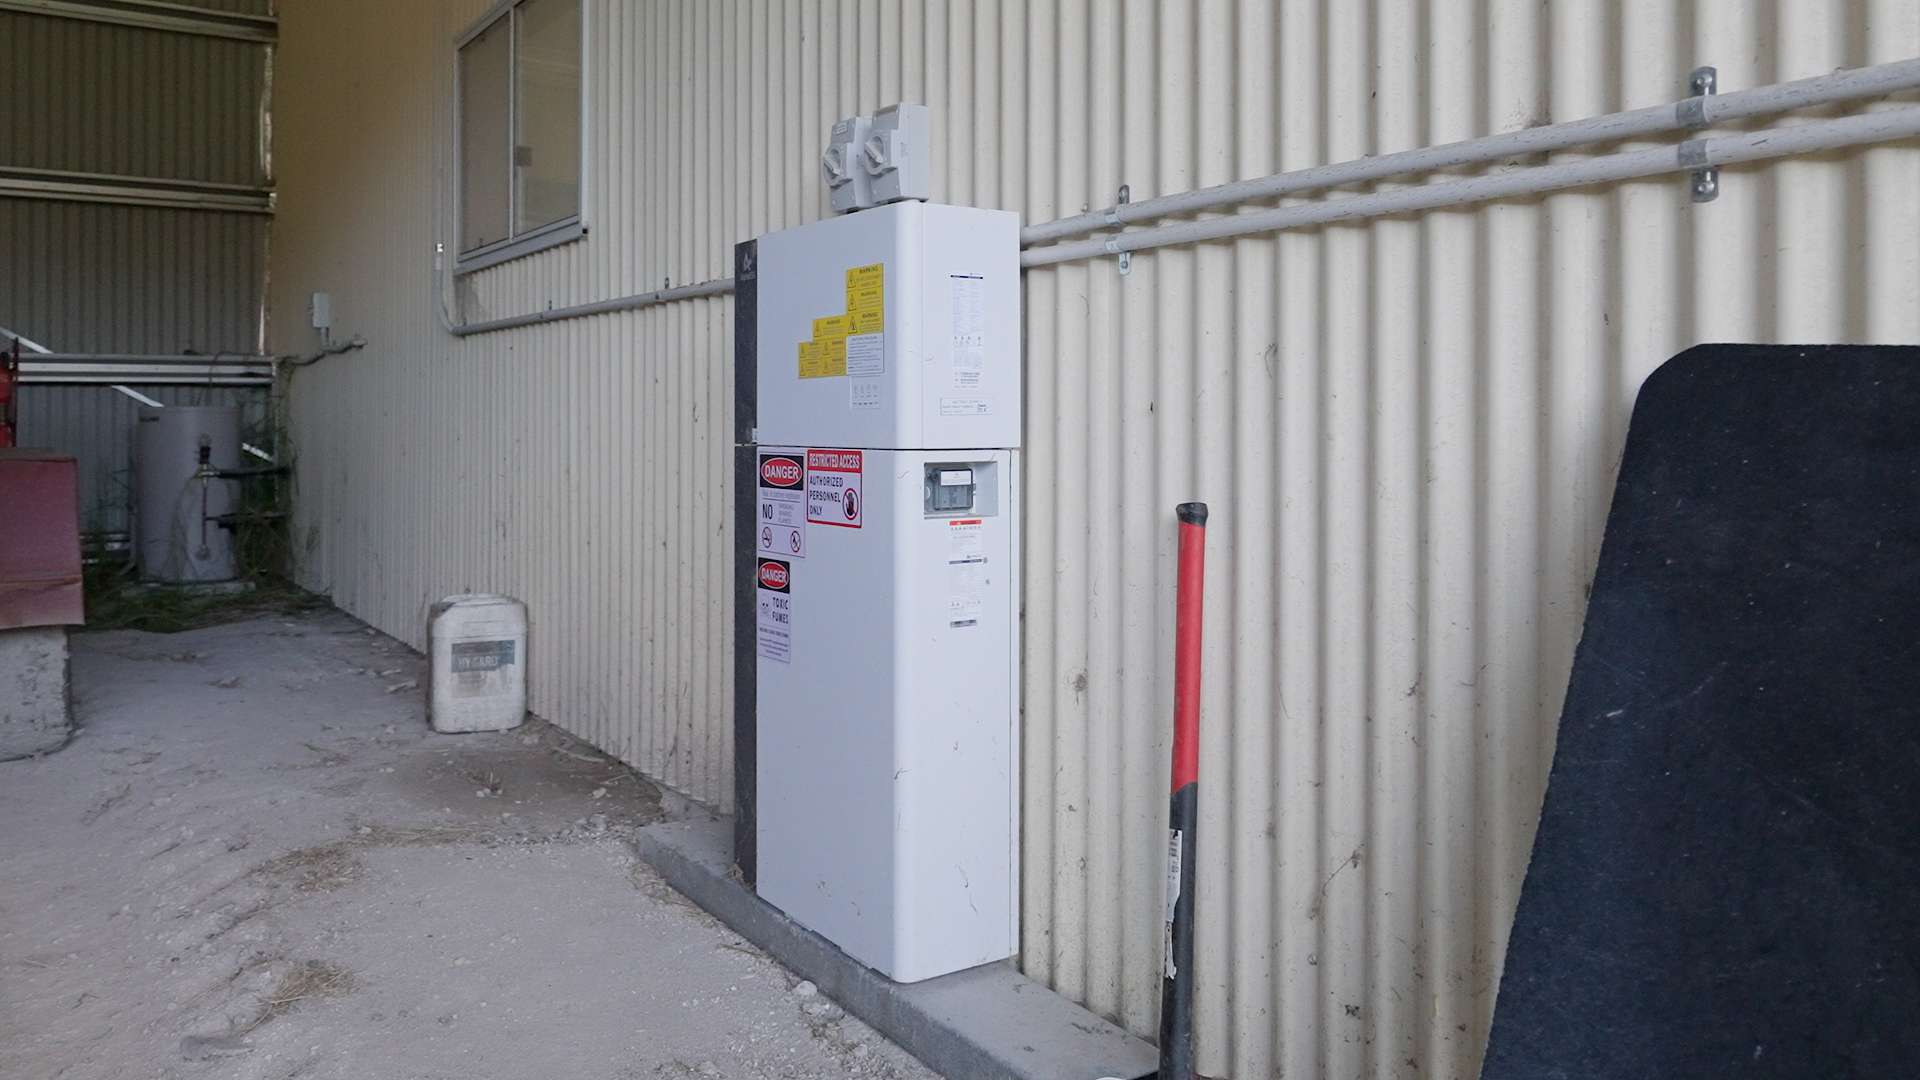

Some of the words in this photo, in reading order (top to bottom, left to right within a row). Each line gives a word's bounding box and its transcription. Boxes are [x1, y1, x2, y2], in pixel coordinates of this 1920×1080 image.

[809, 453, 839, 468] RESTRICTED
[840, 454, 860, 469] ACCESS
[765, 464, 799, 480] DANGER
[809, 476, 844, 488] AUTHORIZED
[809, 490, 841, 503] PERSONNEL
[762, 503, 773, 520] NO
[809, 505, 823, 516] ONLY
[761, 567, 787, 583] DANGER
[772, 596, 789, 610] TOXIC
[772, 611, 789, 624] FUMES
